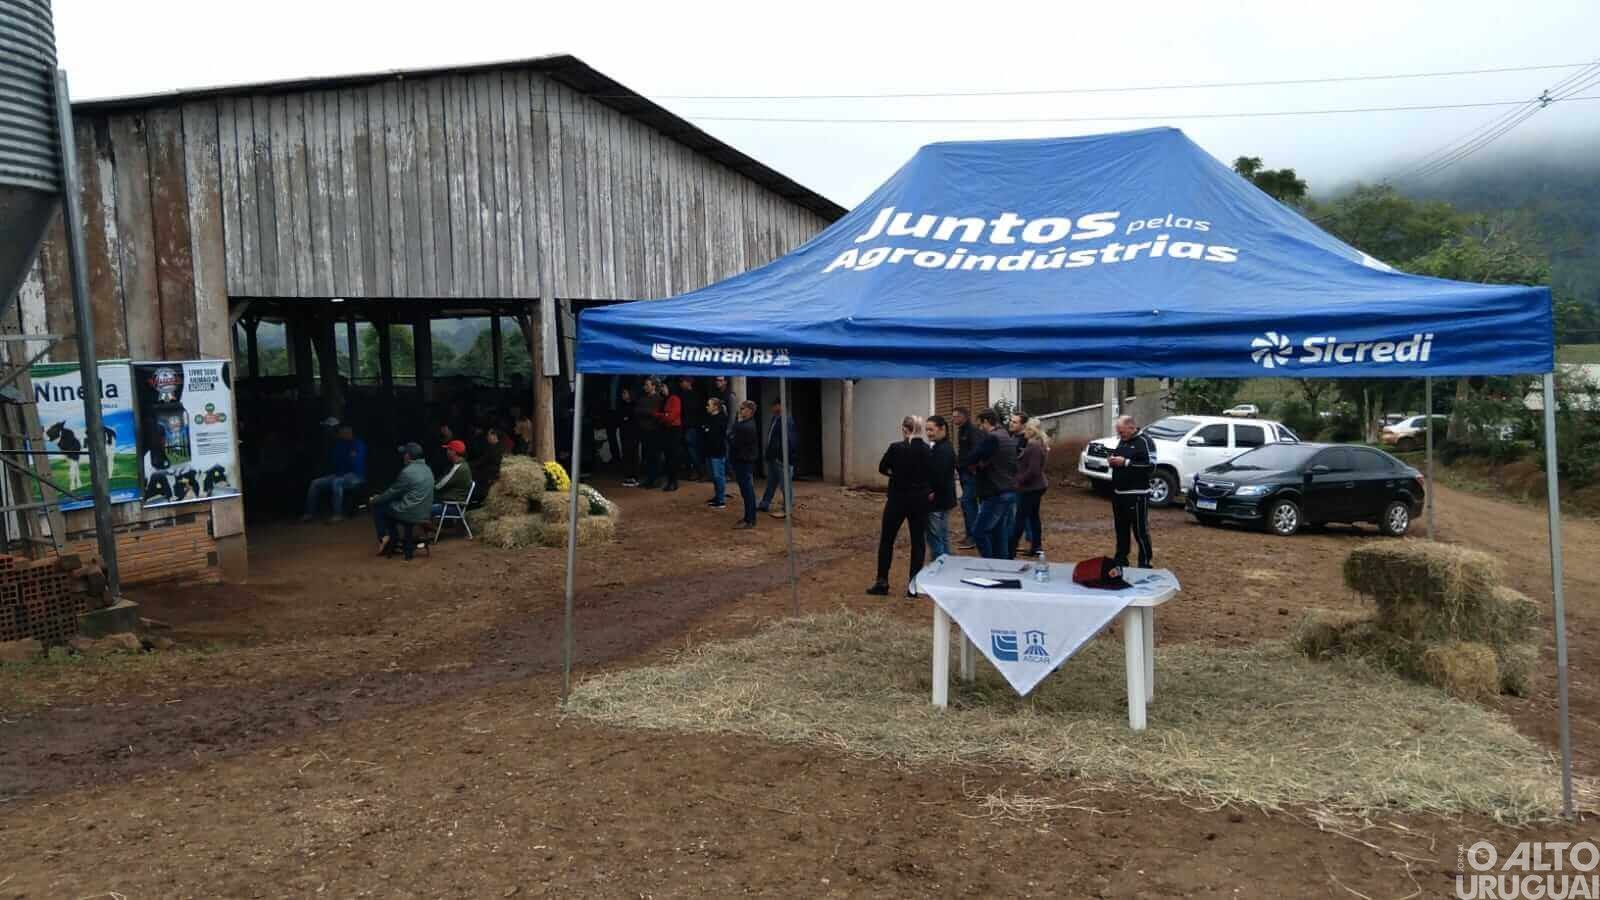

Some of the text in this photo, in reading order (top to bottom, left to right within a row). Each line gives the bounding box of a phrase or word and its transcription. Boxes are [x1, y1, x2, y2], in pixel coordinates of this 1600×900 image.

[854, 205, 1212, 246] Juntos pelas
[821, 234, 1241, 273] Agroindústrias
[671, 345, 774, 365] EMATER/RS
[1299, 333, 1434, 364] Sicredi
[34, 378, 119, 403] Ninela
